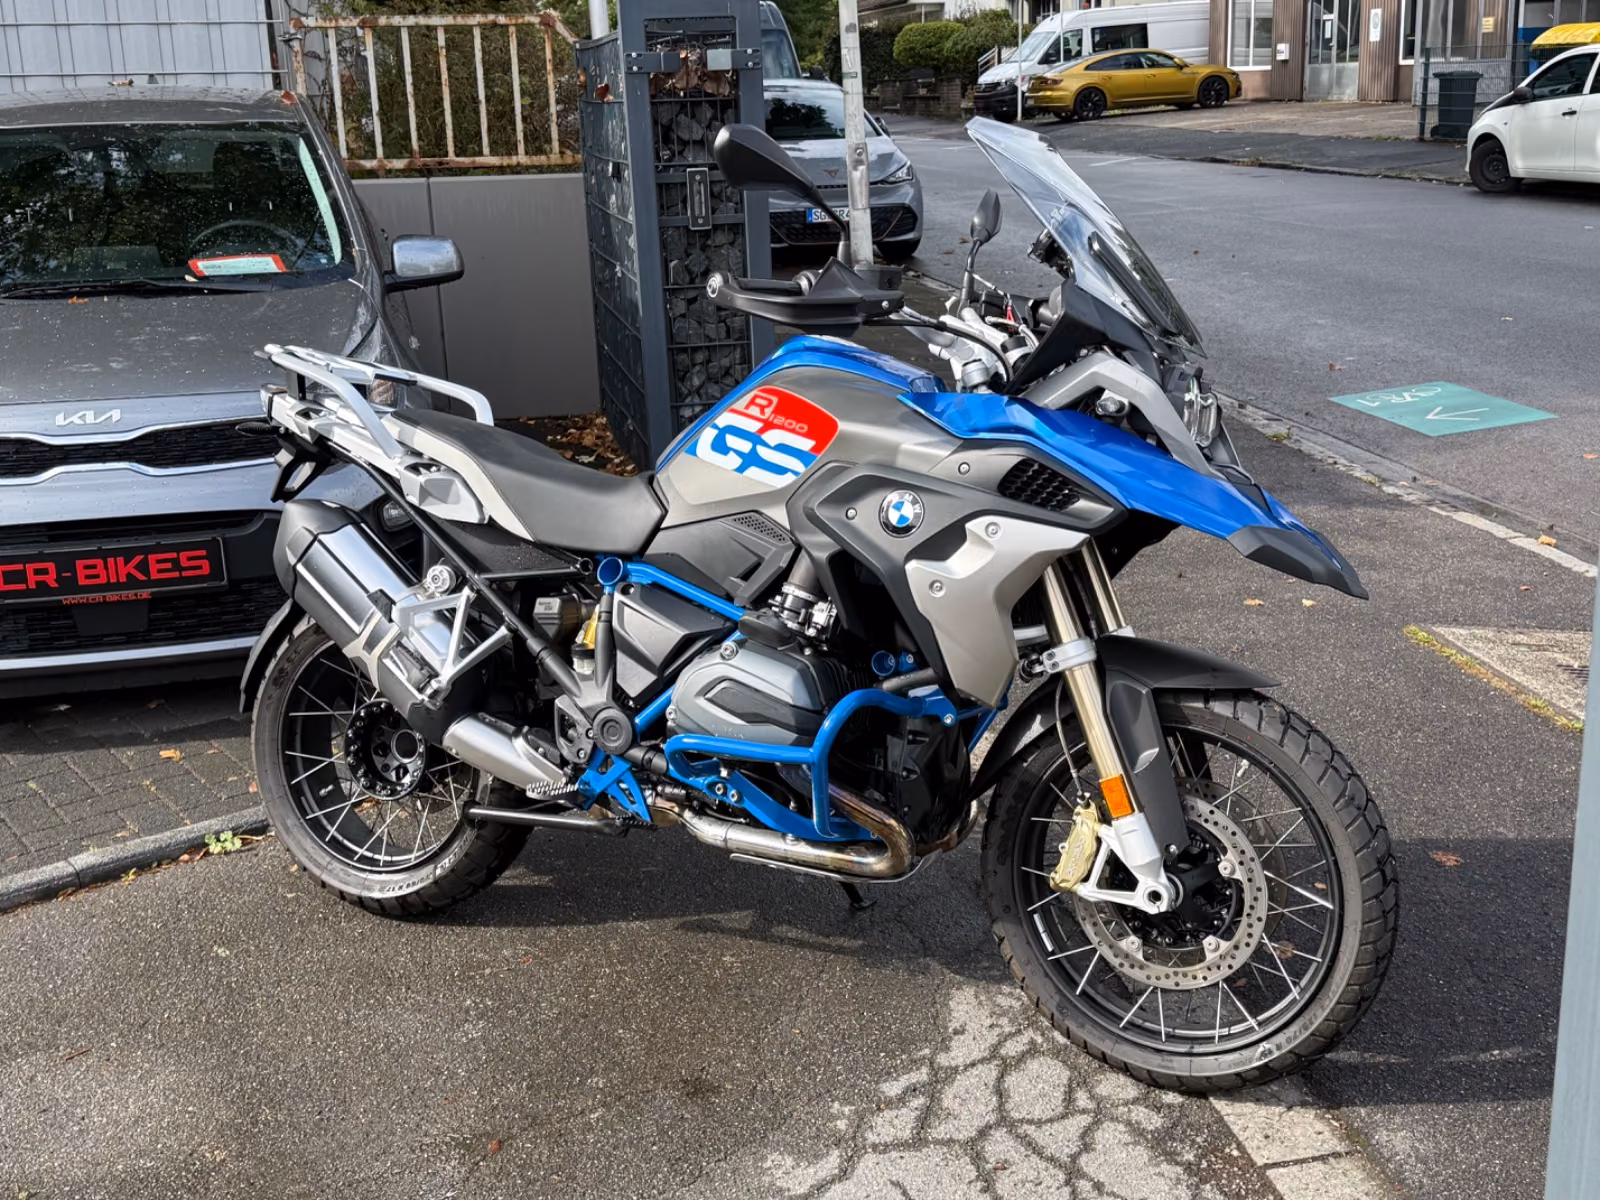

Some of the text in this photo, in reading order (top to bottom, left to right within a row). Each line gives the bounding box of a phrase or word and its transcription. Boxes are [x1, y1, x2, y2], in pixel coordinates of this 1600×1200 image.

[744, 393, 775, 417] R
[55, 408, 121, 427] KIA
[768, 414, 808, 433] 1200
[696, 411, 816, 488] GS
[0, 549, 211, 592] CR-BIKES
